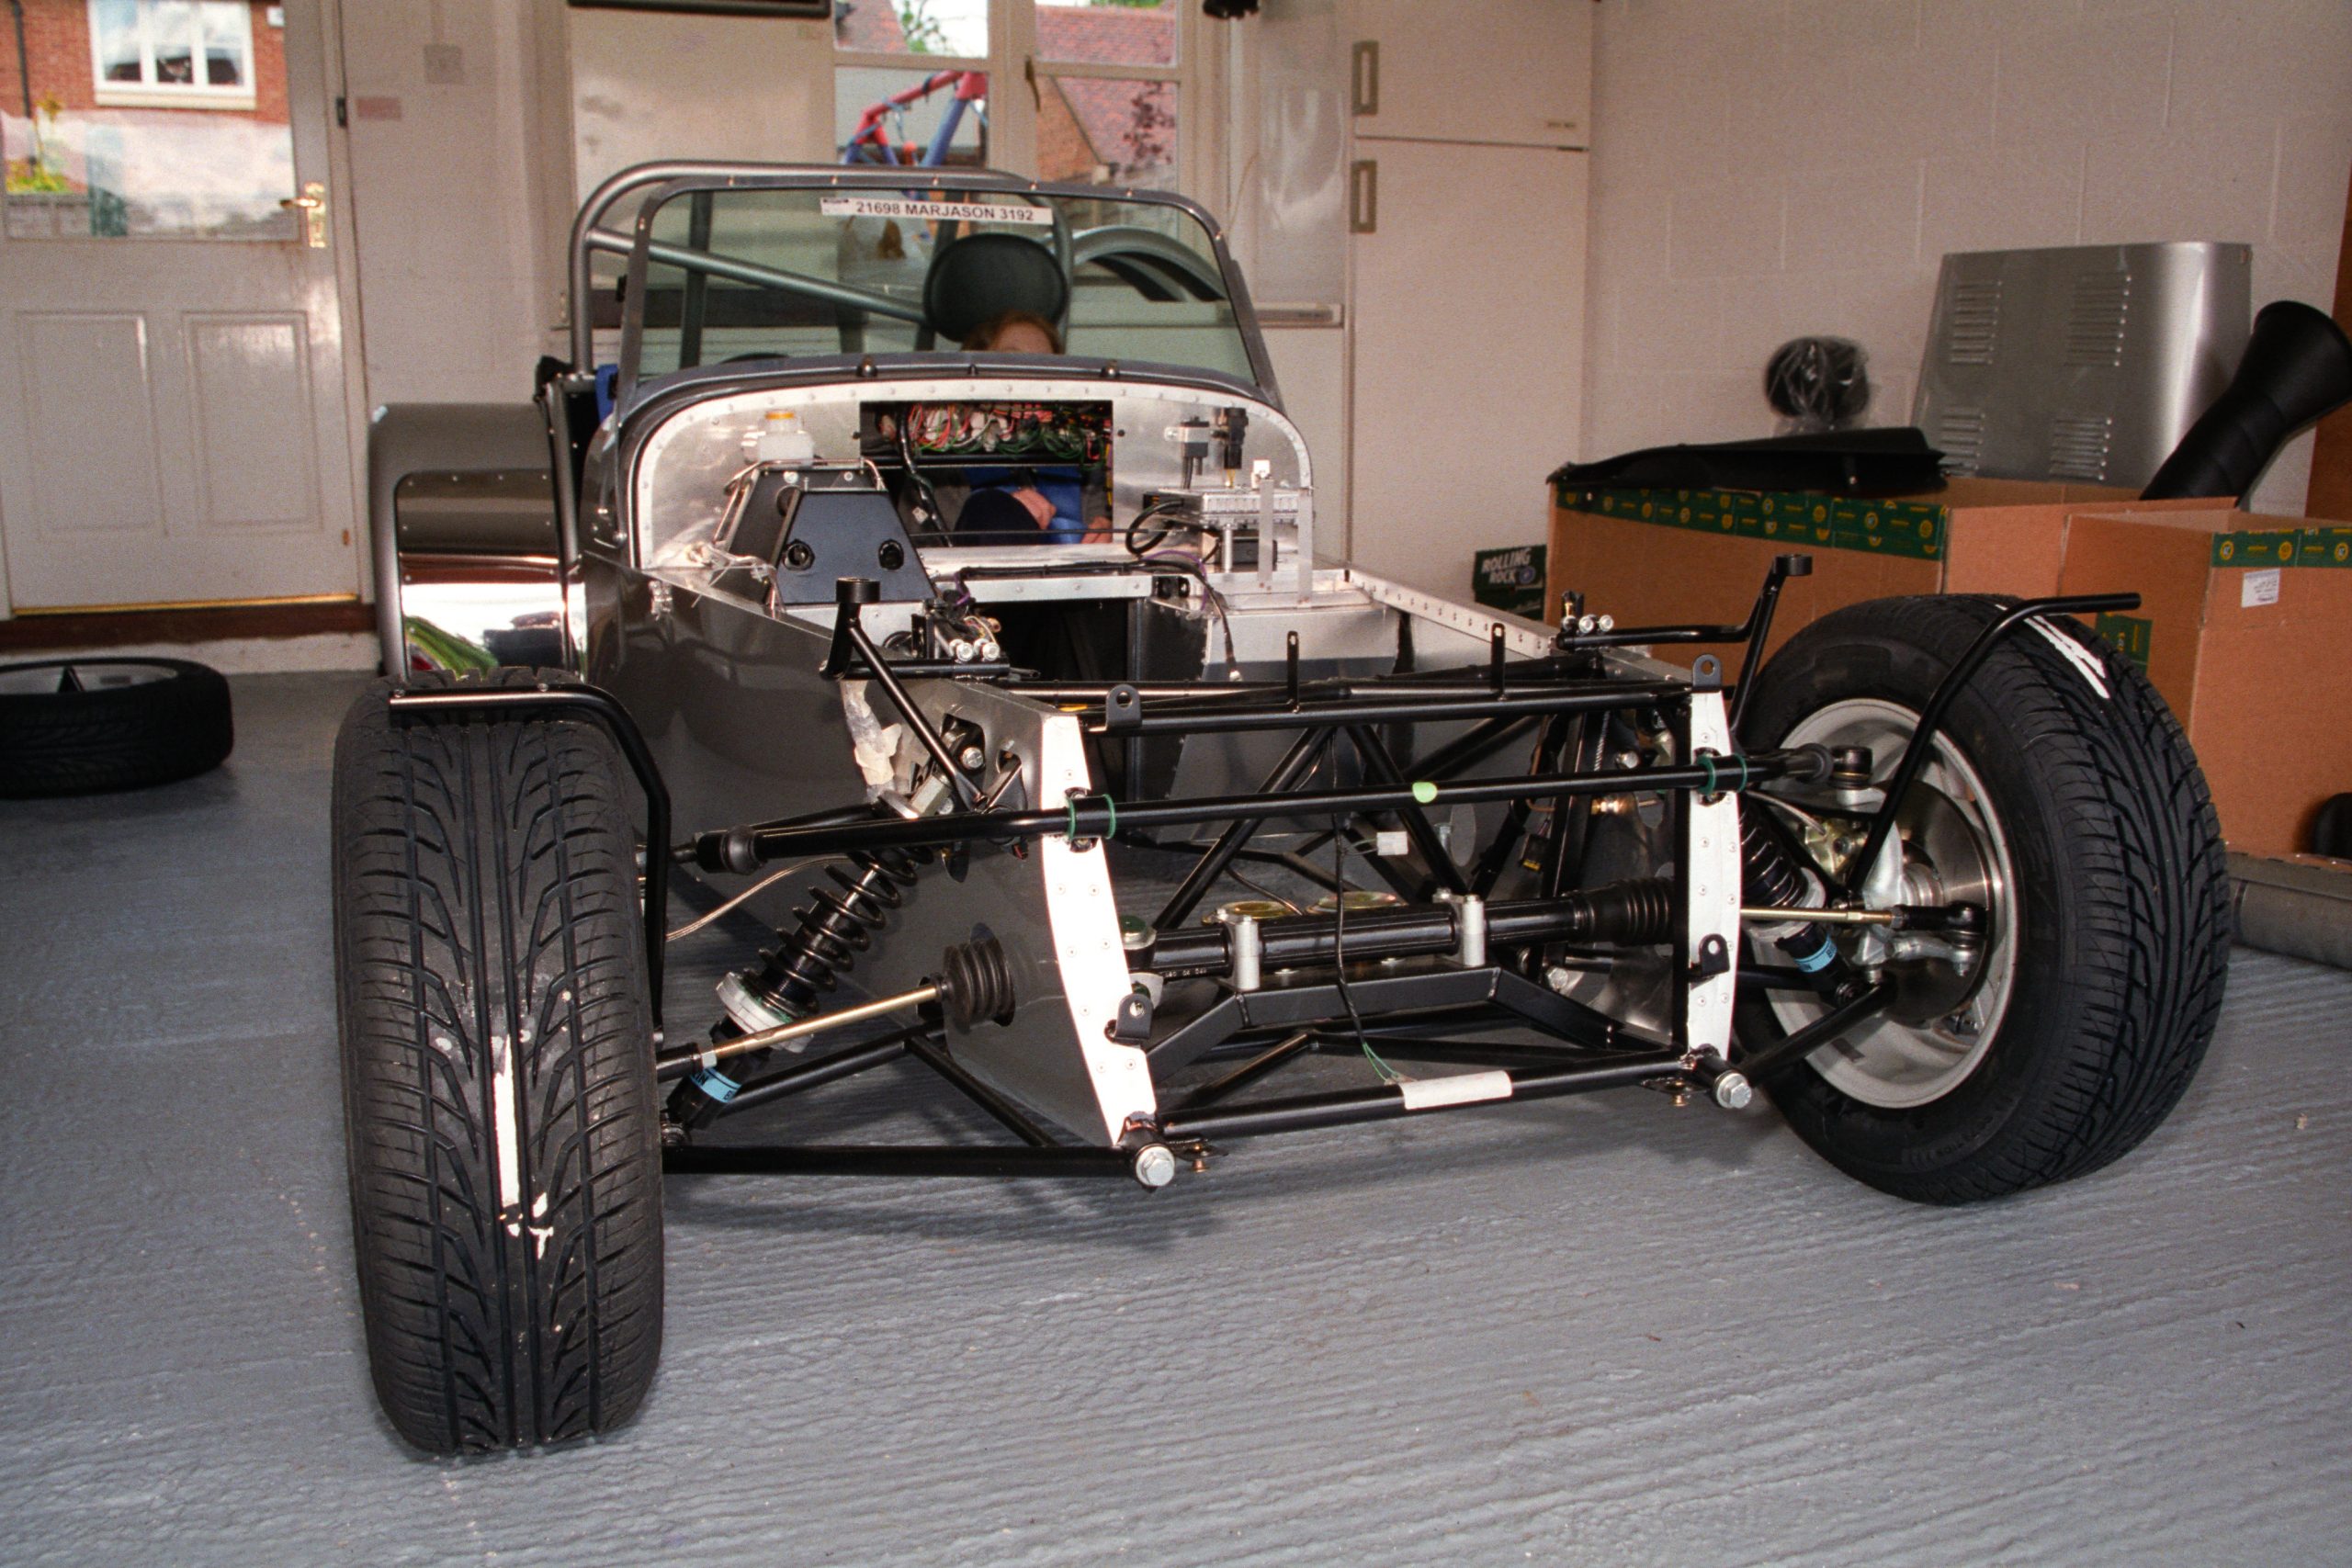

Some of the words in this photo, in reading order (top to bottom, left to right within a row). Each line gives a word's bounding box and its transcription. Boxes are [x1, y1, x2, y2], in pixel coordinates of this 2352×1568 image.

[856, 201, 900, 214] 21698
[905, 203, 995, 219] MARJASON
[1000, 208, 1034, 221] 3192
[1481, 547, 1532, 574] ROLLING
